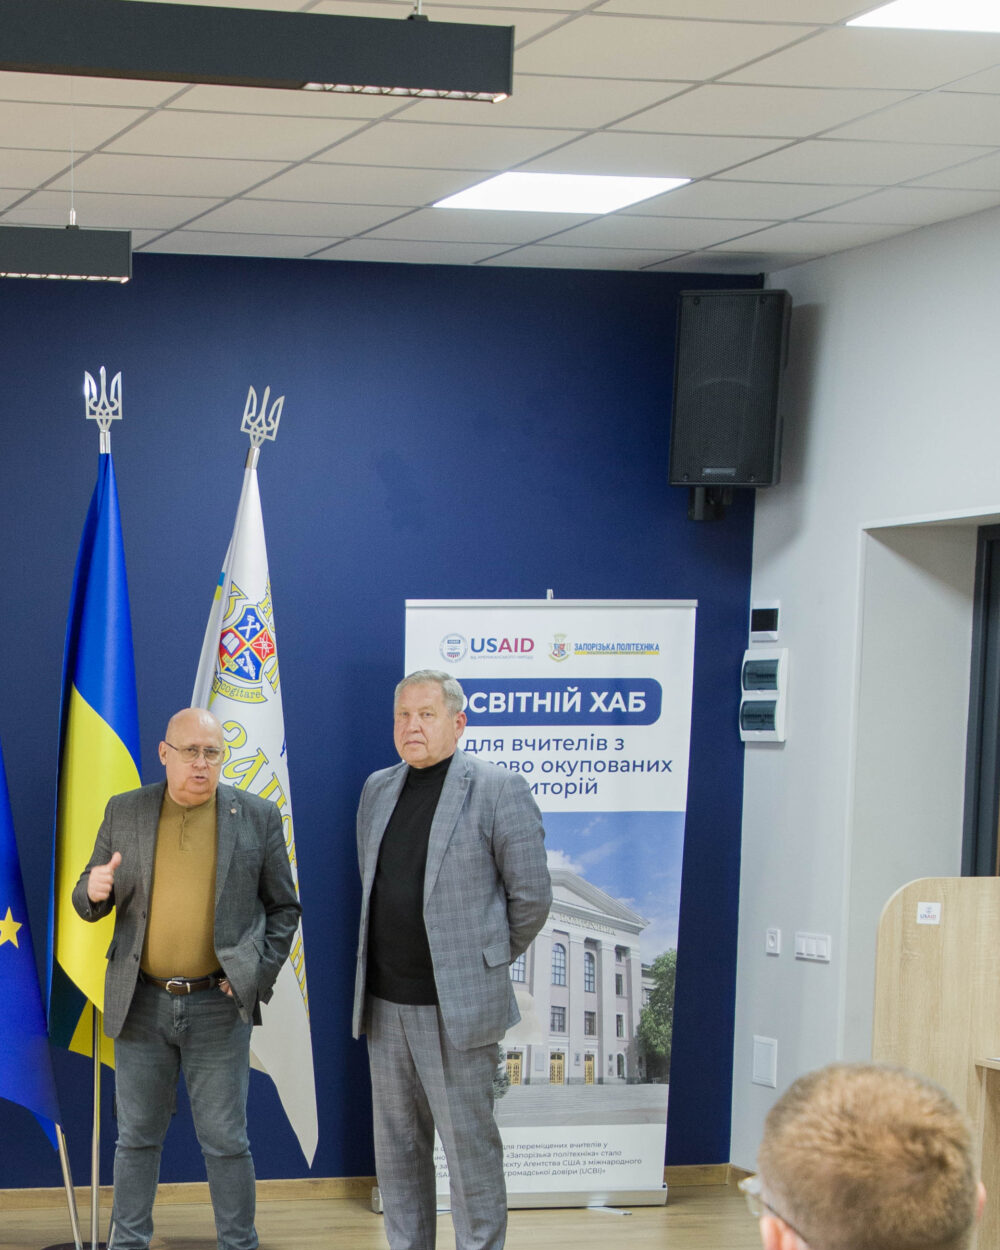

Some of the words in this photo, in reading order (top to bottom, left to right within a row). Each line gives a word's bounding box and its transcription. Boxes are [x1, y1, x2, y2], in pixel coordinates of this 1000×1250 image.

[471, 638, 535, 653] USAID
[574, 642, 616, 651] ЗАПОРІЗЬКА
[617, 642, 660, 651] ПОЛІТЕХНІКА
[221, 683, 262, 698] cogitare
[589, 691, 647, 713] ХАБ
[464, 738, 504, 754] для
[512, 733, 608, 751] вчителів
[614, 738, 625, 751] з
[541, 759, 673, 777] окупованих
